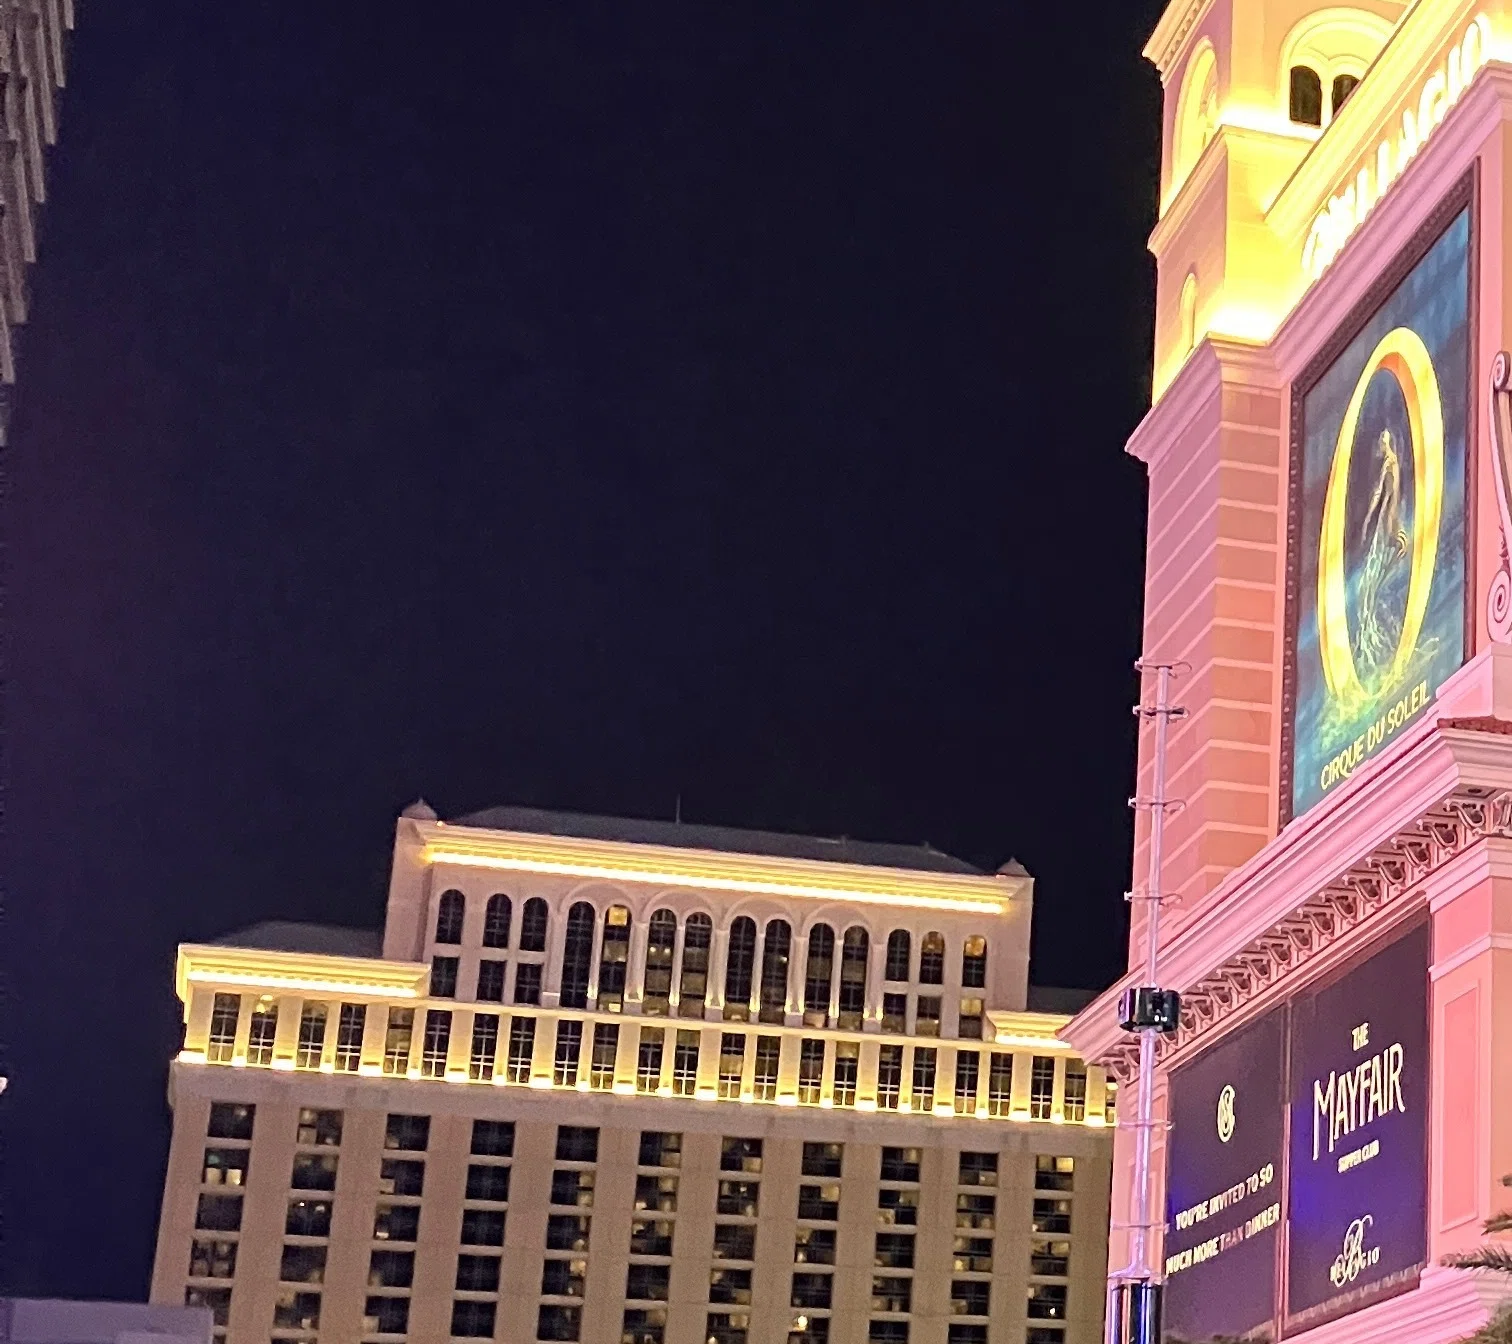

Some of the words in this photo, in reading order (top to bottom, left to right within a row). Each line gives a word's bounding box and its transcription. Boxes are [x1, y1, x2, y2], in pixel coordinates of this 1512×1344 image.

[1320, 734, 1366, 790] CIRQUE
[1367, 716, 1386, 752] DU
[1387, 680, 1432, 734] SOLEIL
[1351, 1022, 1369, 1051] THE
[1312, 1042, 1406, 1161] MAYFAIR
[1175, 1200, 1209, 1231] YOU'RE
[1209, 1182, 1246, 1215] INVITED
[1246, 1173, 1260, 1196] TO
[1260, 1163, 1274, 1187] SO
[1165, 1249, 1192, 1276] MUCH
[1193, 1237, 1219, 1264] MORE
[1219, 1226, 1244, 1252] THAN
[1244, 1203, 1280, 1239] DINNER
[1329, 1246, 1380, 1282] BEGIO
